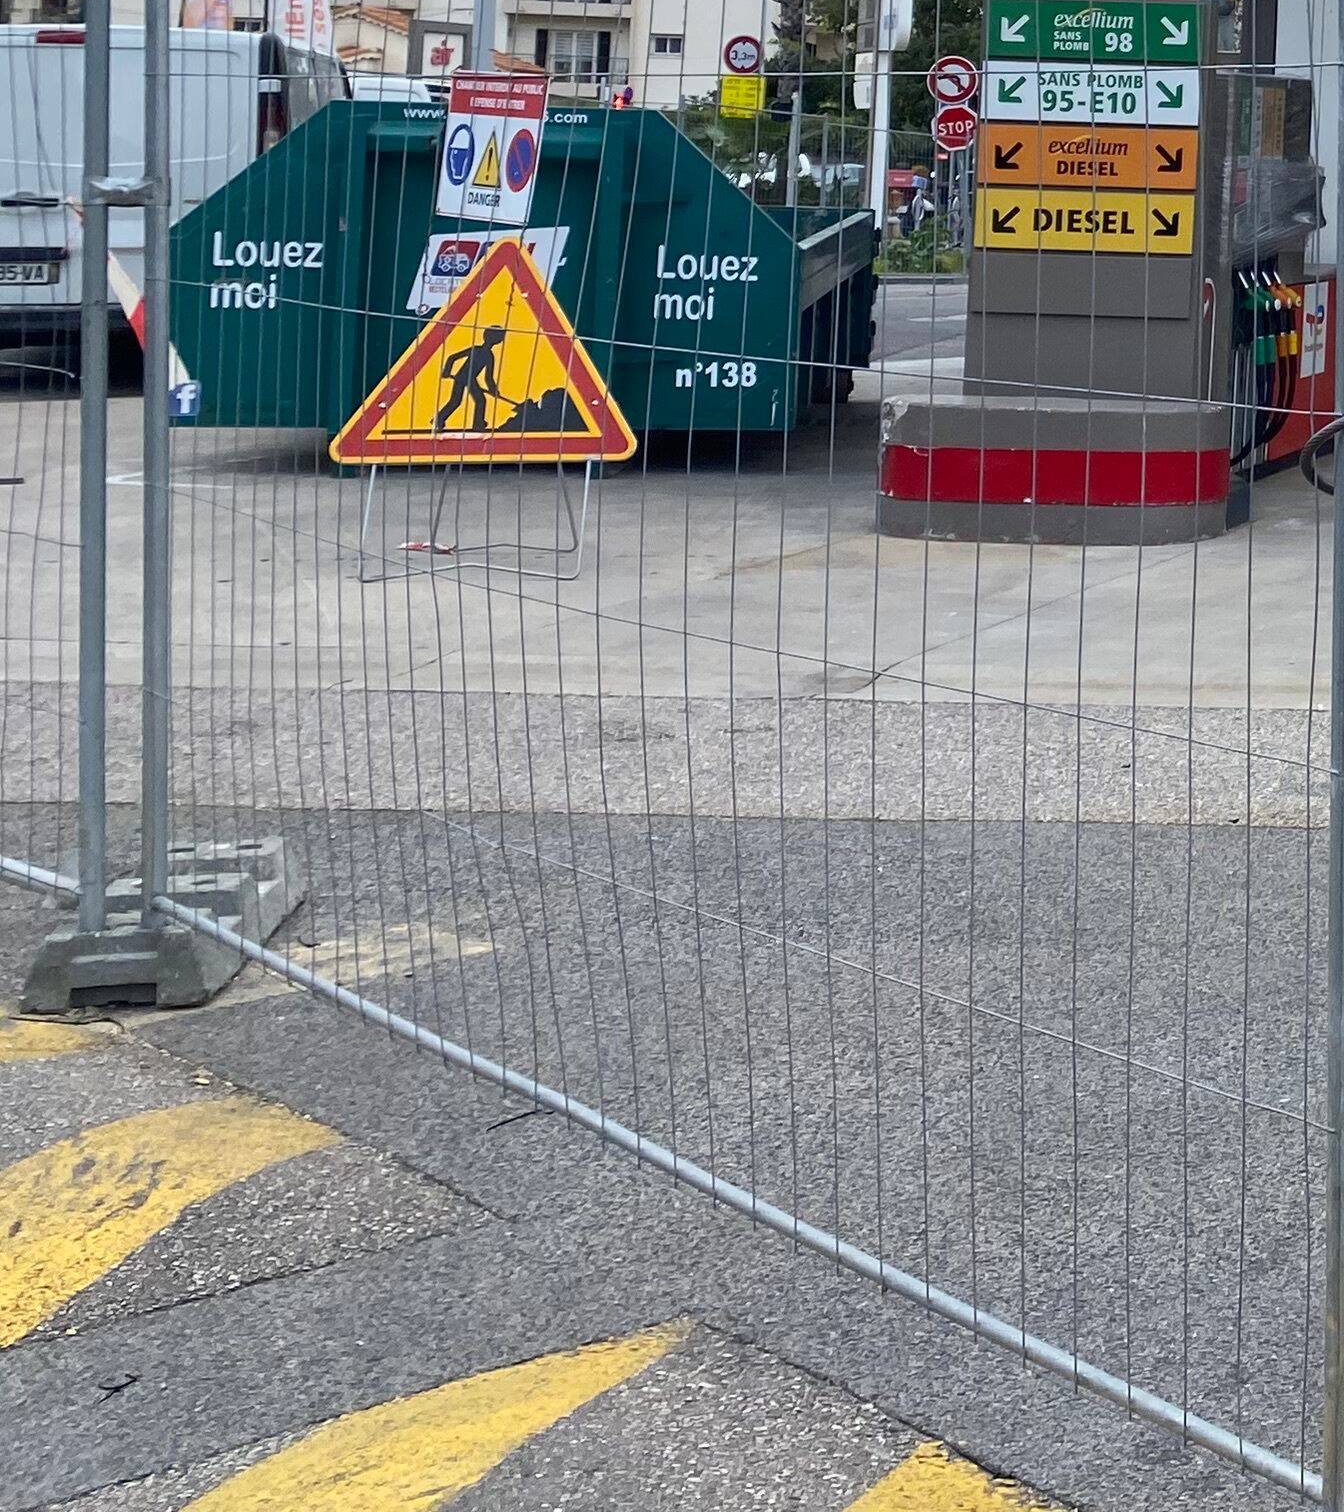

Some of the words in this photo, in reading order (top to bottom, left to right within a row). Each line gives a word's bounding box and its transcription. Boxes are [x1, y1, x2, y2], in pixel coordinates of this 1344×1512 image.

[1053, 9, 1135, 30] excellium
[1053, 30, 1082, 41] SANS
[1104, 32, 1133, 53] 98
[1053, 41, 1090, 51] PLOMB
[1038, 72, 1081, 87] SANS
[1086, 73, 1144, 90] PLOMB
[1042, 90, 1138, 116] 95-E10
[937, 120, 974, 136] STOP
[1048, 137, 1129, 157] excellium
[1056, 160, 1119, 177] DIESEL
[467, 191, 501, 207] DANGER
[1032, 208, 1136, 236] DIESEL
[212, 230, 324, 269] Louez
[656, 244, 759, 282] Louez
[209, 273, 277, 310] moi
[653, 286, 715, 321] moi
